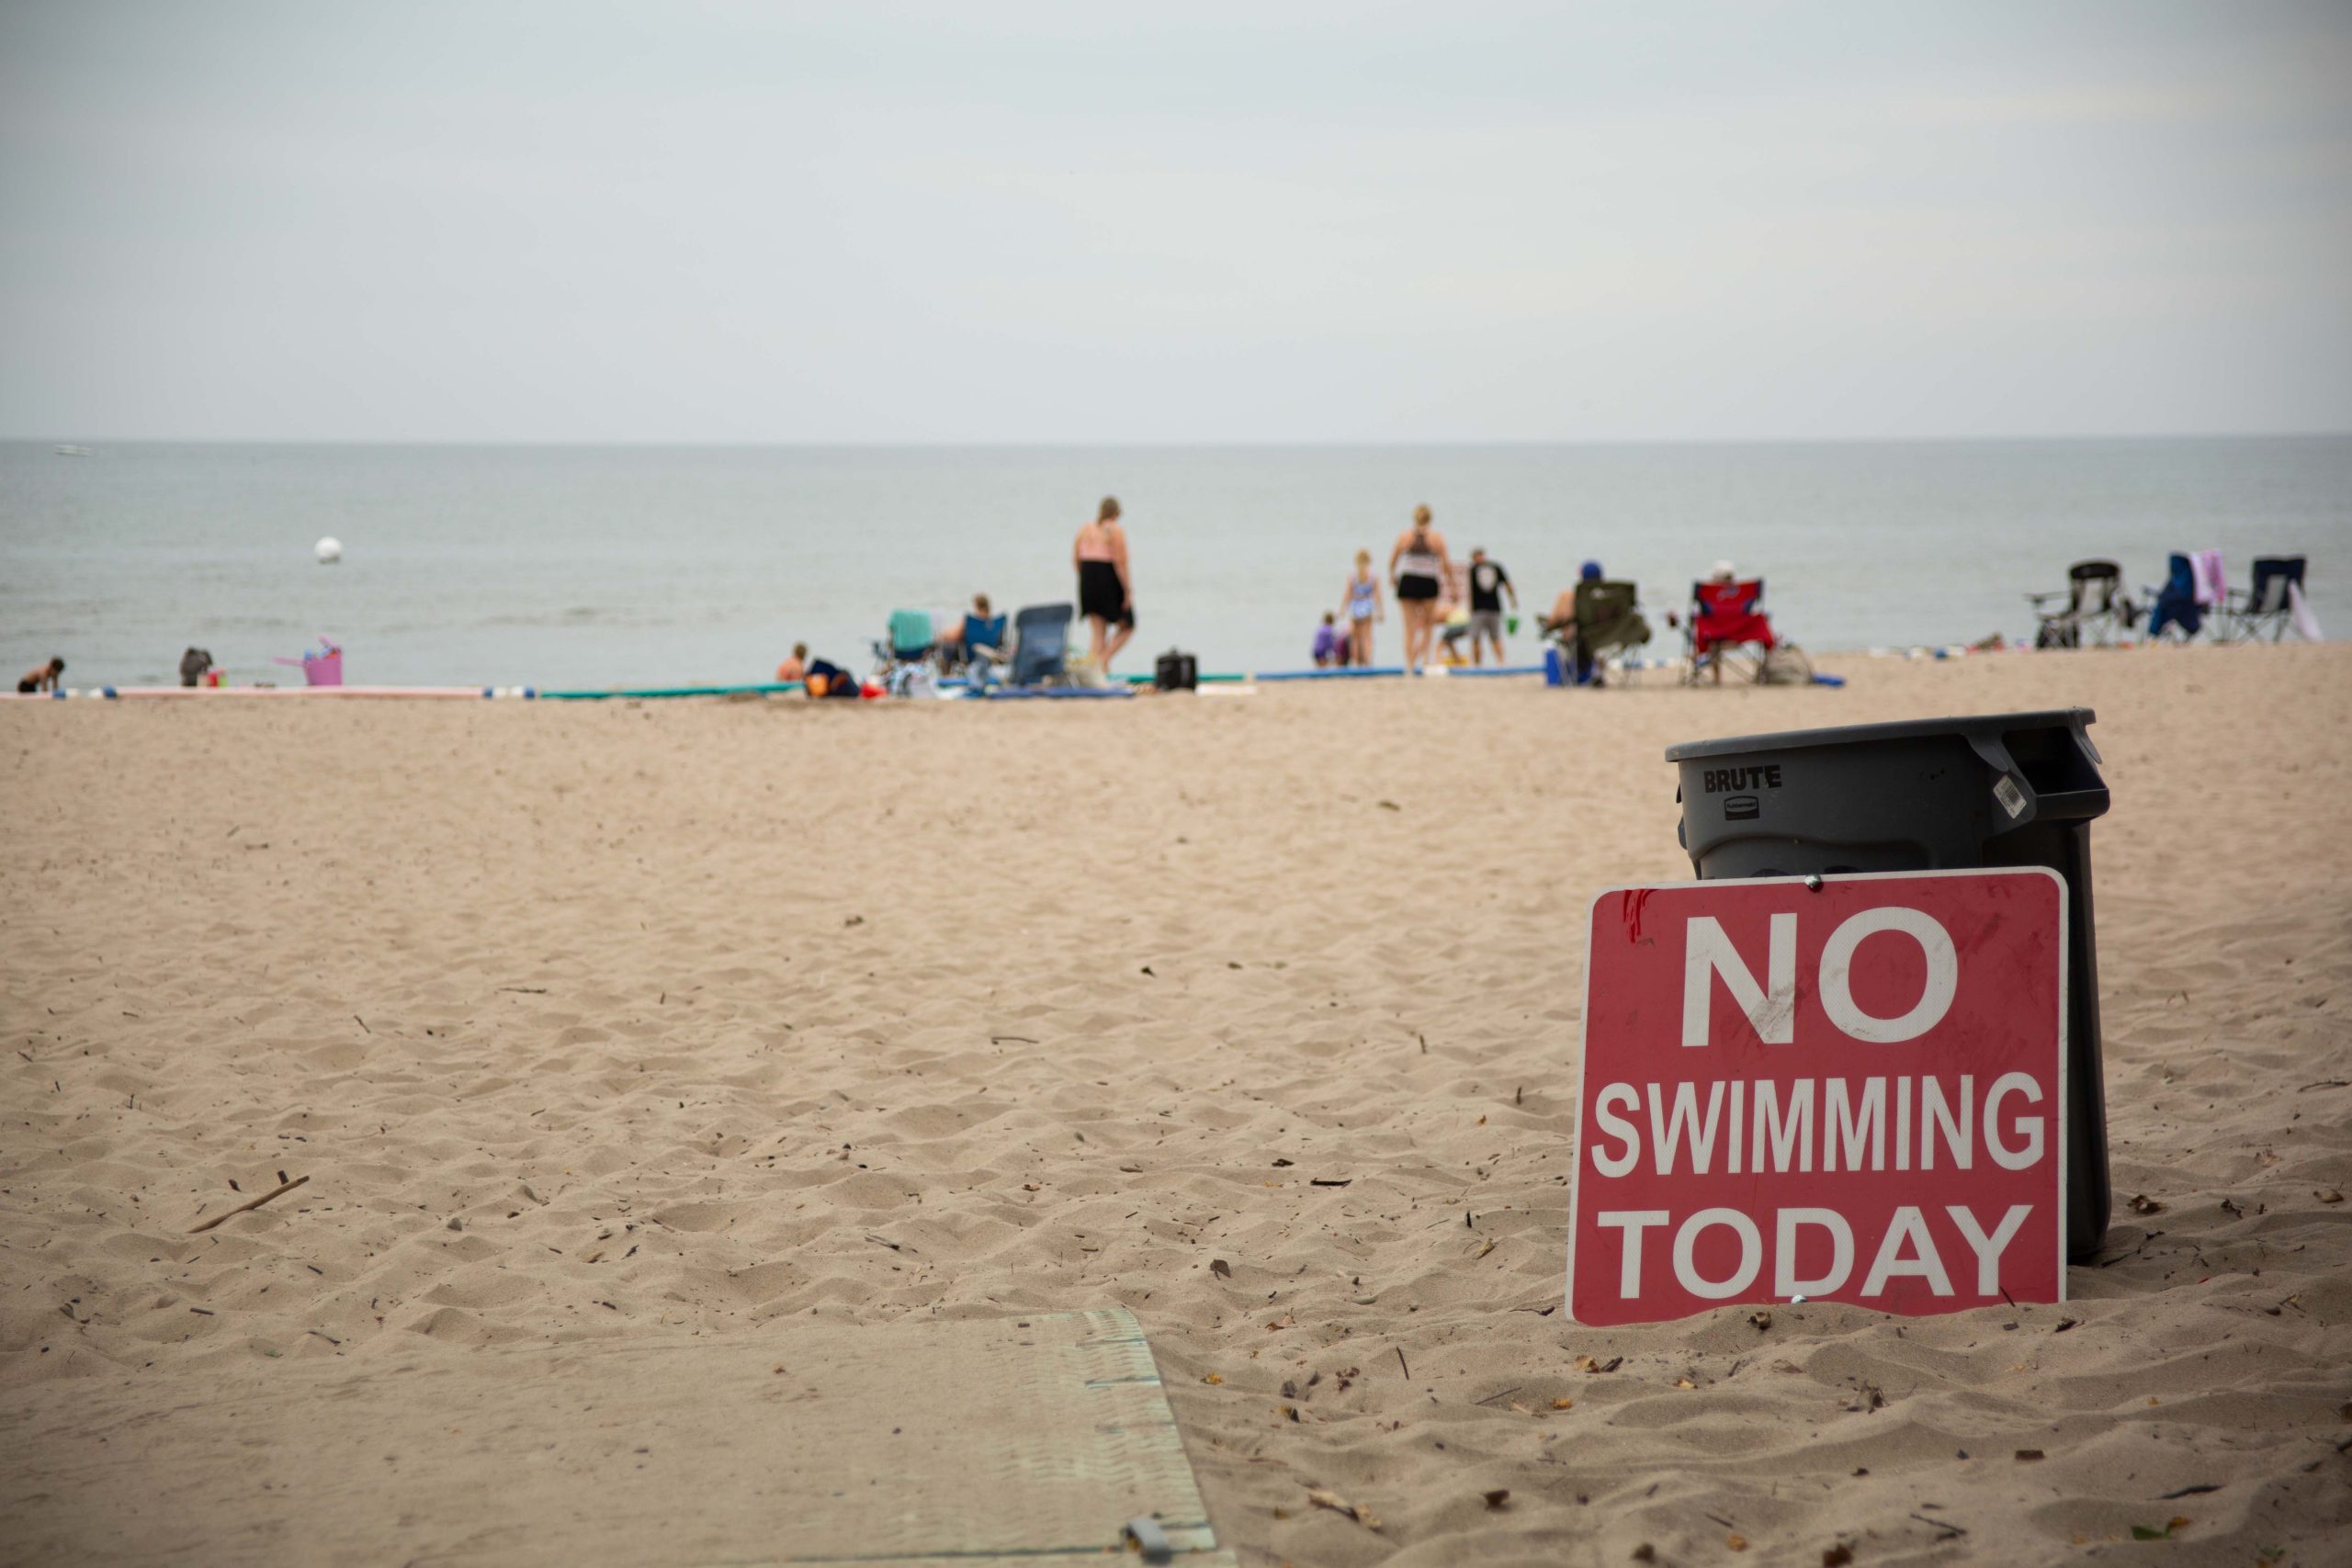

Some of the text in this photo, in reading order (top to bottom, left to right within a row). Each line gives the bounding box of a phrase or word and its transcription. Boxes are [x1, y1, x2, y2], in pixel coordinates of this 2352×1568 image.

[1703, 765, 1782, 793] BRUTE
[1682, 907, 1958, 1046] NO
[1591, 1072, 2044, 1178] SWIMMING
[1598, 1205, 2033, 1300] TODAY
